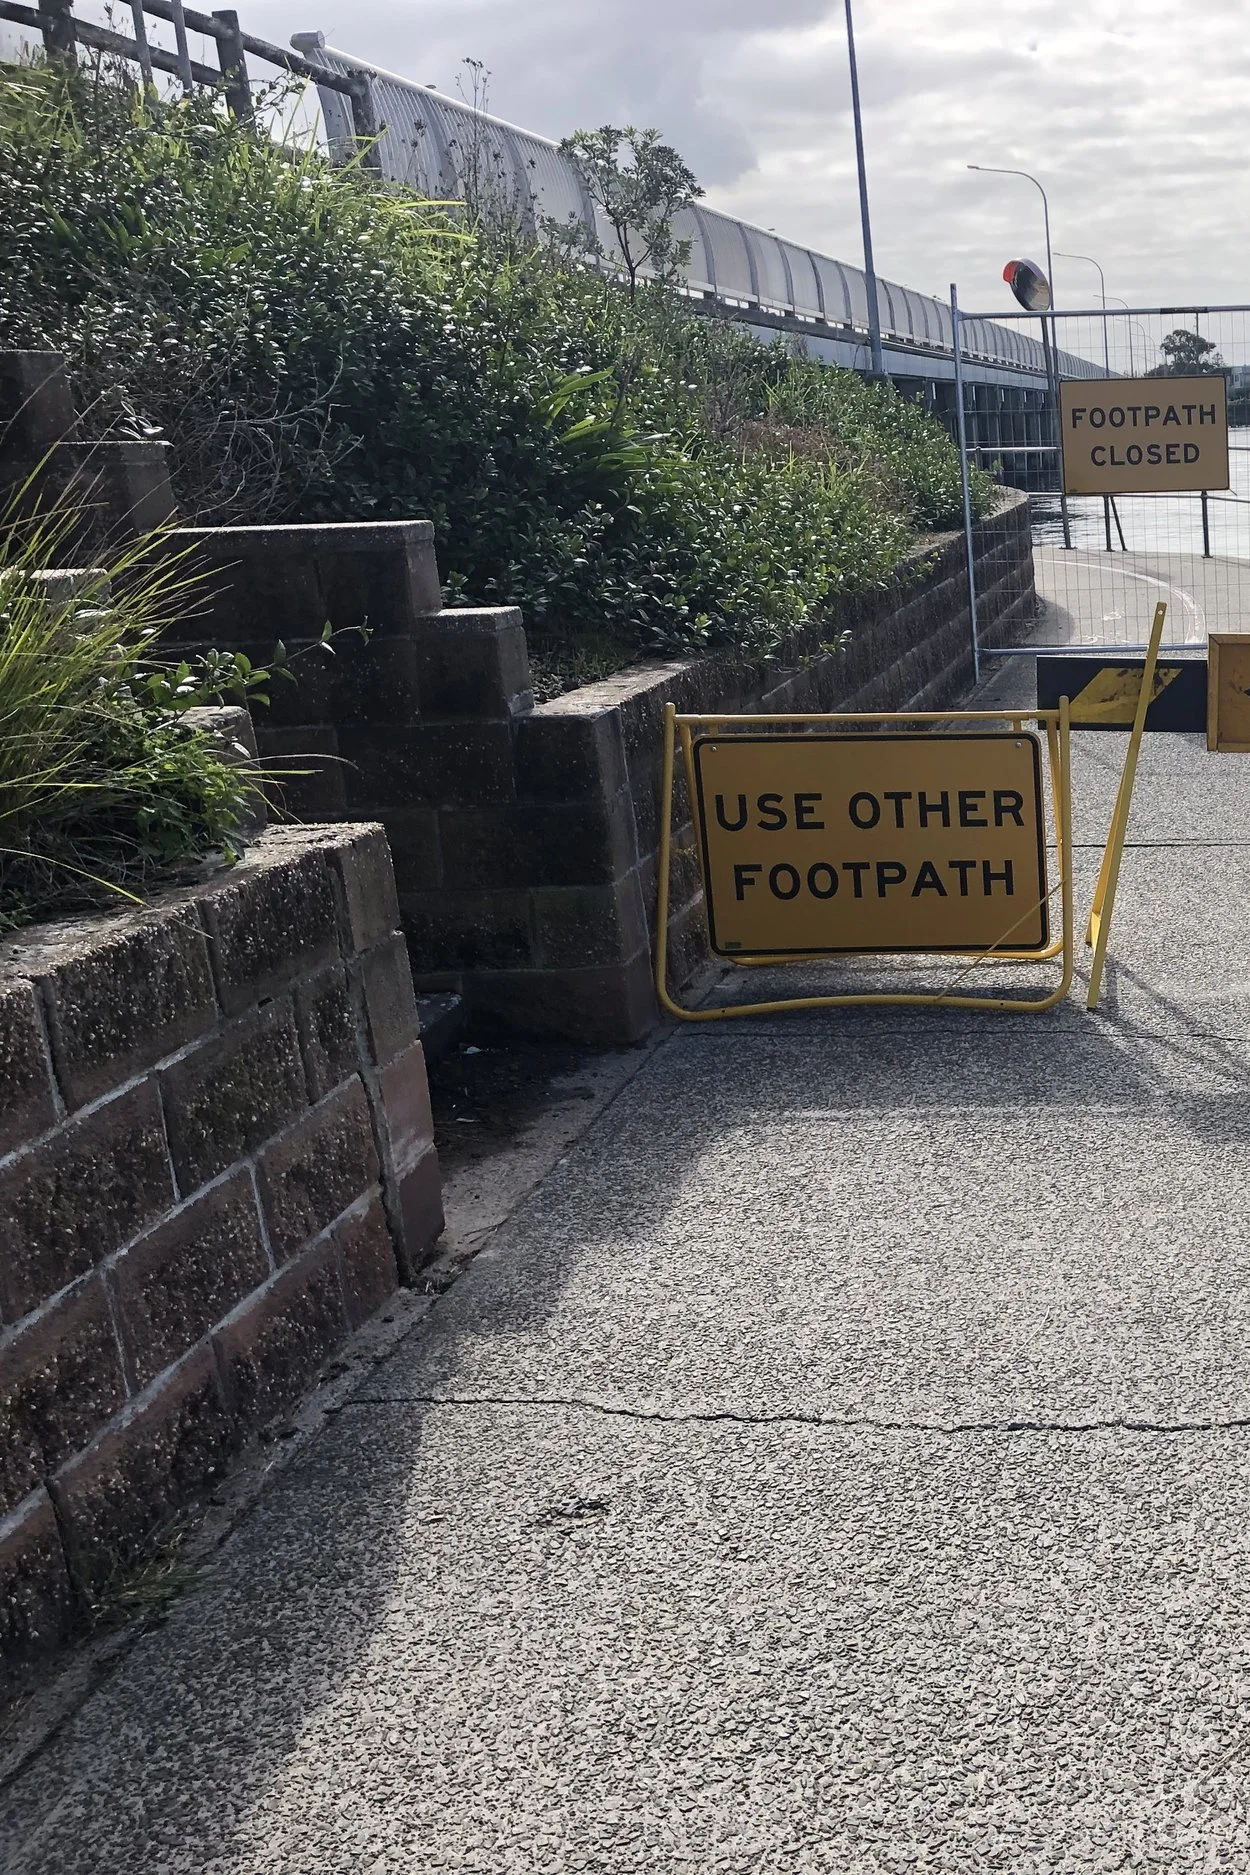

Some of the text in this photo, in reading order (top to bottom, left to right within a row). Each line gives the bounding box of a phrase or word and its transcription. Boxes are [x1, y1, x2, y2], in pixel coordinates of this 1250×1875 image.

[1071, 403, 1216, 428] FOOTPATH
[1090, 443, 1200, 467] CLOSED
[714, 790, 1025, 832] USE OTHER
[733, 860, 1014, 900] FOOTPATH
